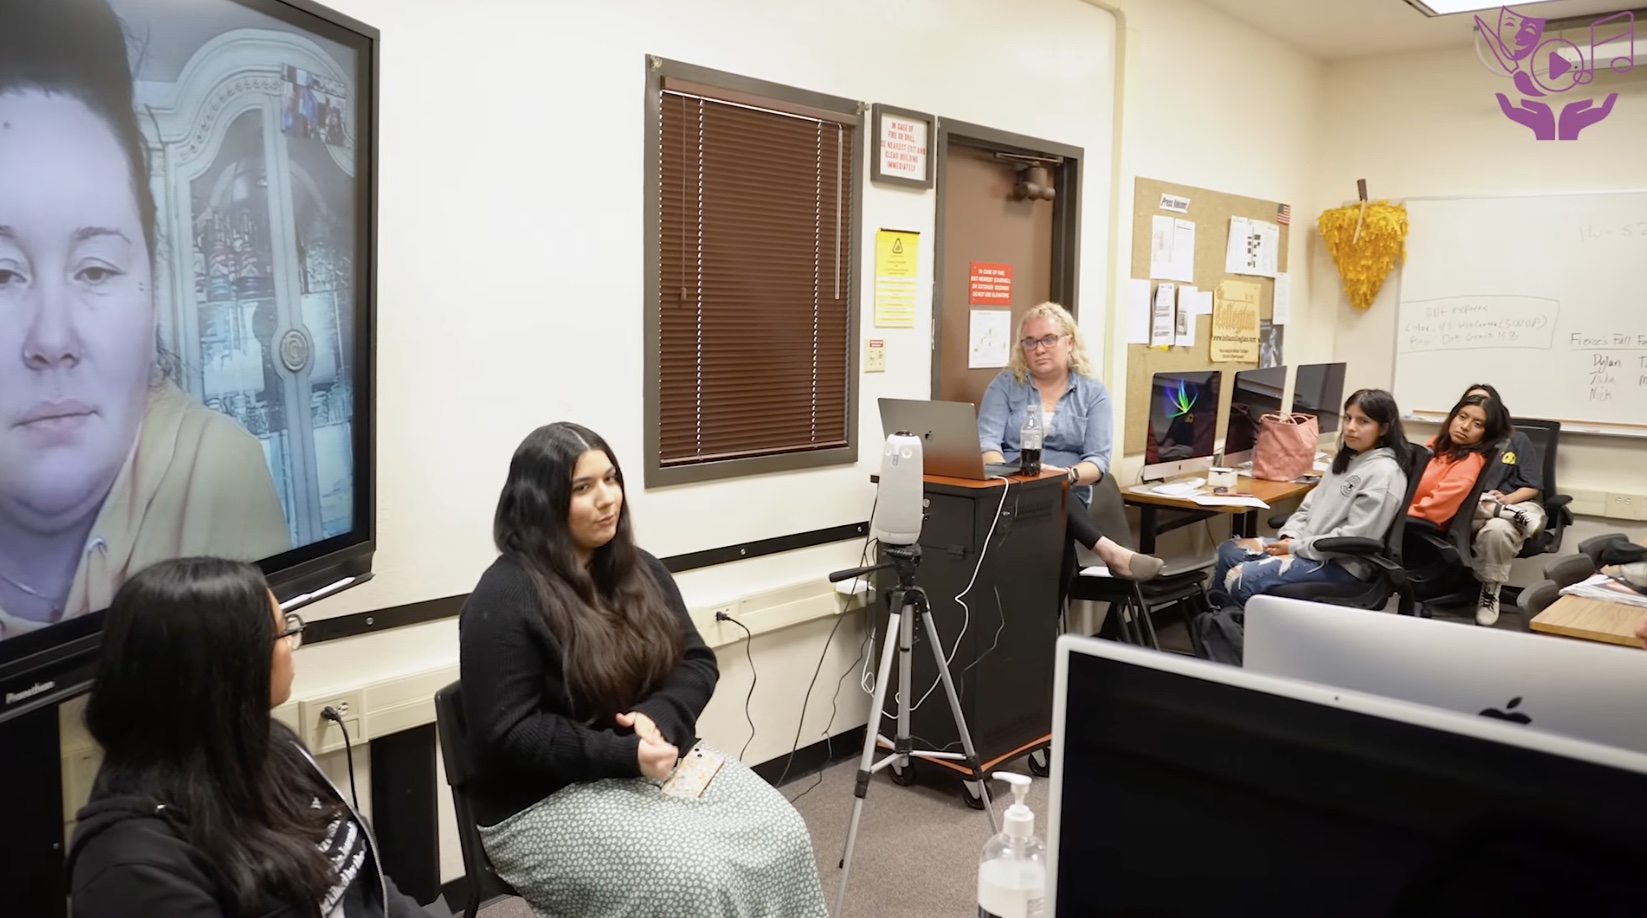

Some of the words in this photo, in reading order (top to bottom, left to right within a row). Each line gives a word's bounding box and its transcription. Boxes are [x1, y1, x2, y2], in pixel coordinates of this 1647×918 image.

[898, 123, 908, 132] CASE
[888, 130, 897, 139] FIRE
[904, 134, 916, 142] DRILL
[888, 142, 906, 151] NEAREST
[907, 145, 916, 154] EXIT
[917, 148, 926, 156] AND
[886, 150, 898, 159] CLEAR
[900, 154, 918, 163] BUILDING
[887, 161, 916, 172] IMMEDIATELY
